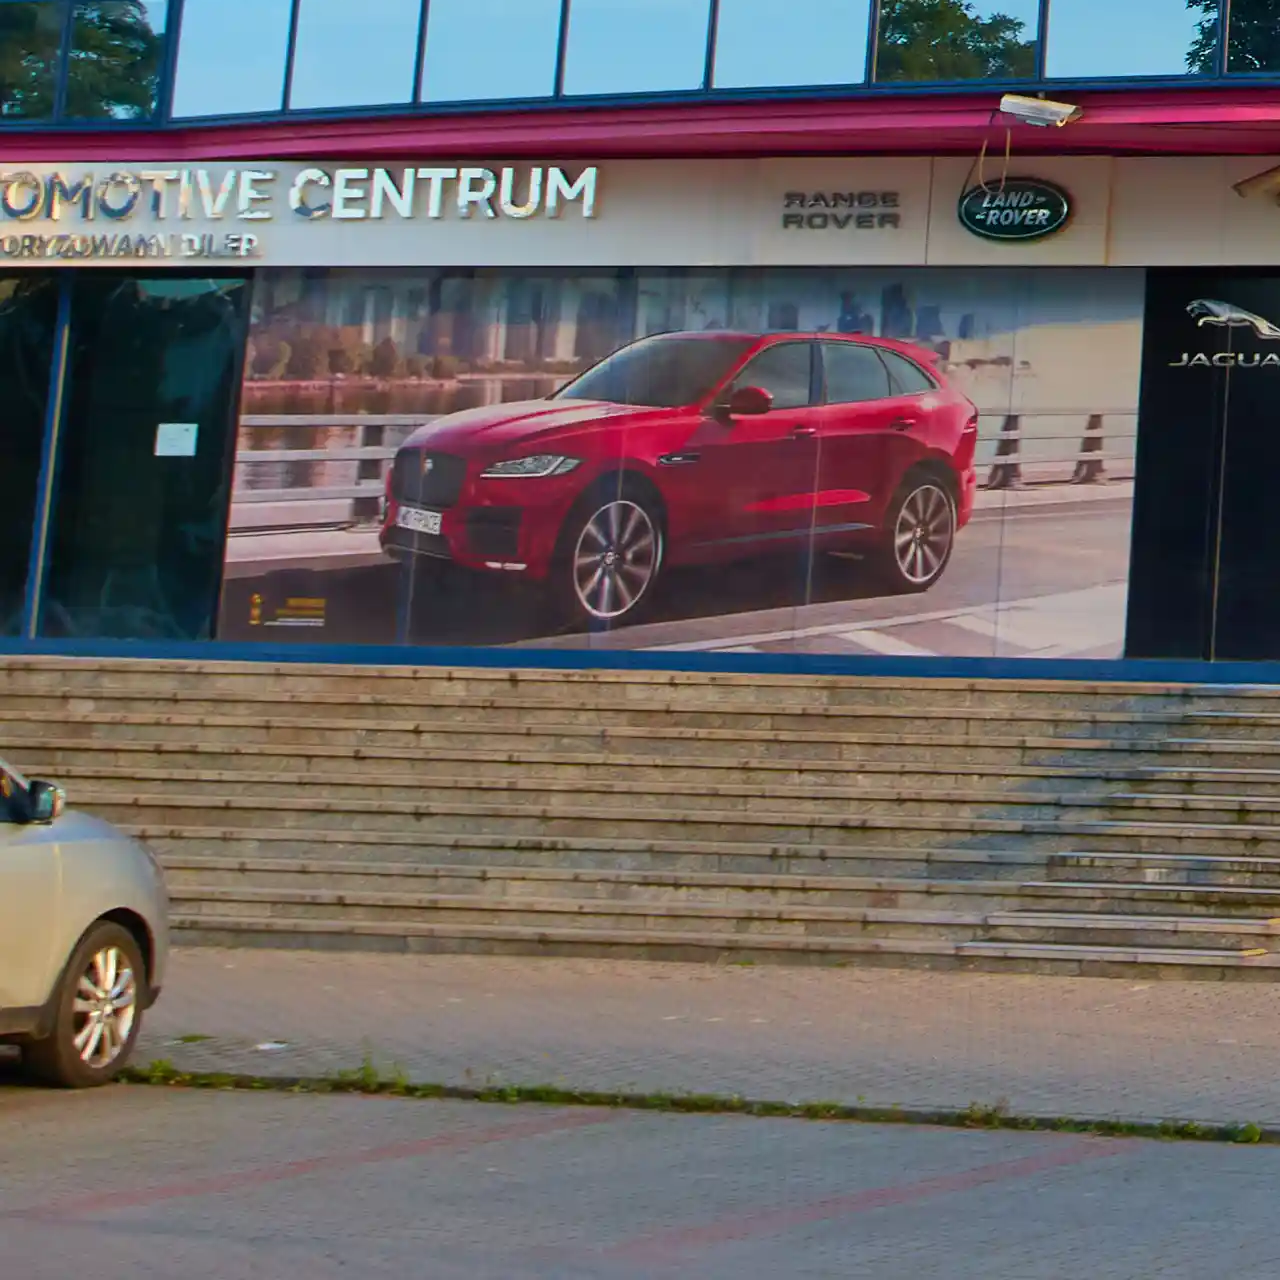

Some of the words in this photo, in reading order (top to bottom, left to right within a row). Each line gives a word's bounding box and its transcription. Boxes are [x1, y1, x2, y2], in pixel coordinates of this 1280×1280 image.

[0, 170, 276, 220] OMOTIVE
[289, 167, 599, 220] CENTRUM
[783, 192, 900, 208] RANGE
[982, 191, 1034, 208] LAND
[782, 212, 900, 229] ROVER
[986, 209, 1051, 226] ROVER
[0, 233, 176, 258] ORYZOWANY
